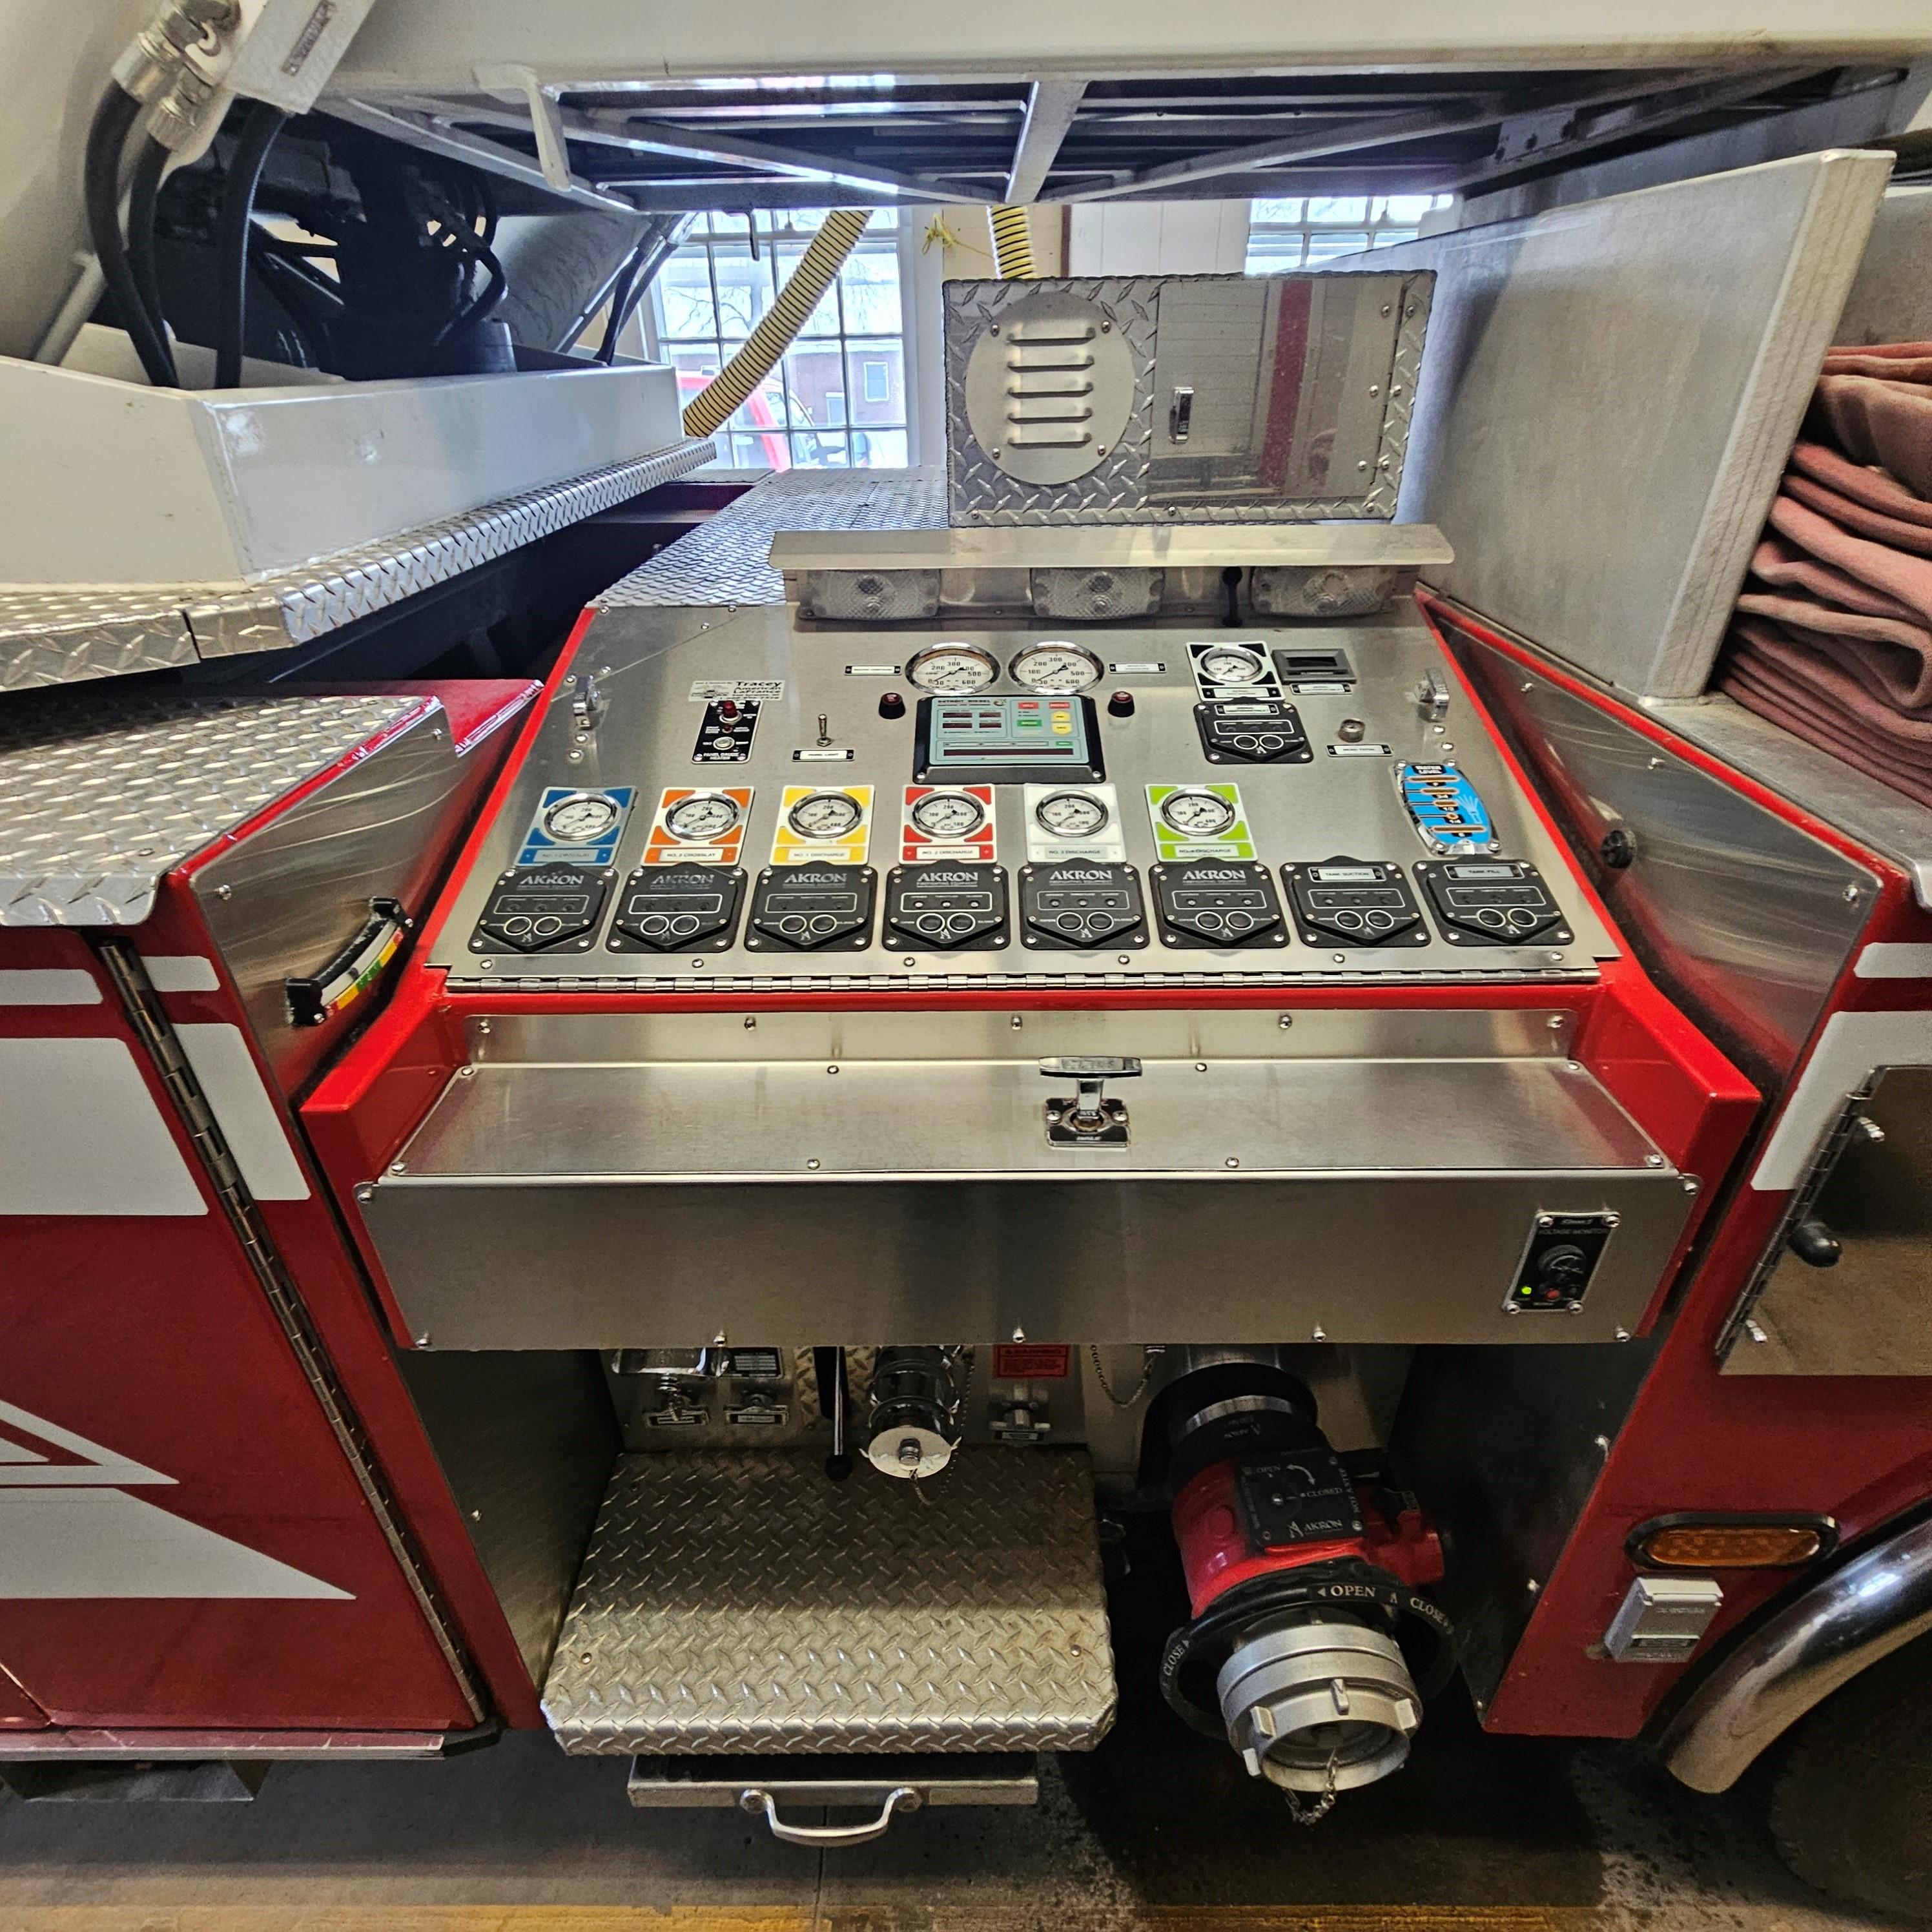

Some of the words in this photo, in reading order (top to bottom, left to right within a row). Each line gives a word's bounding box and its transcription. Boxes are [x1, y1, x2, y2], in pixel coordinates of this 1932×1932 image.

[651, 874, 715, 884] AKRON
[785, 873, 847, 883] AKRON
[917, 872, 978, 881] AKRON
[1050, 870, 1113, 879] AKRON
[1182, 870, 1246, 879] AKRON
[520, 875, 584, 885] AKRON
[1304, 1519, 1343, 1532] AKRON
[1330, 1585, 1376, 1598] OPEN
[1410, 1597, 1445, 1624] CLOSE
[1163, 1645, 1186, 1677] CLOSE
